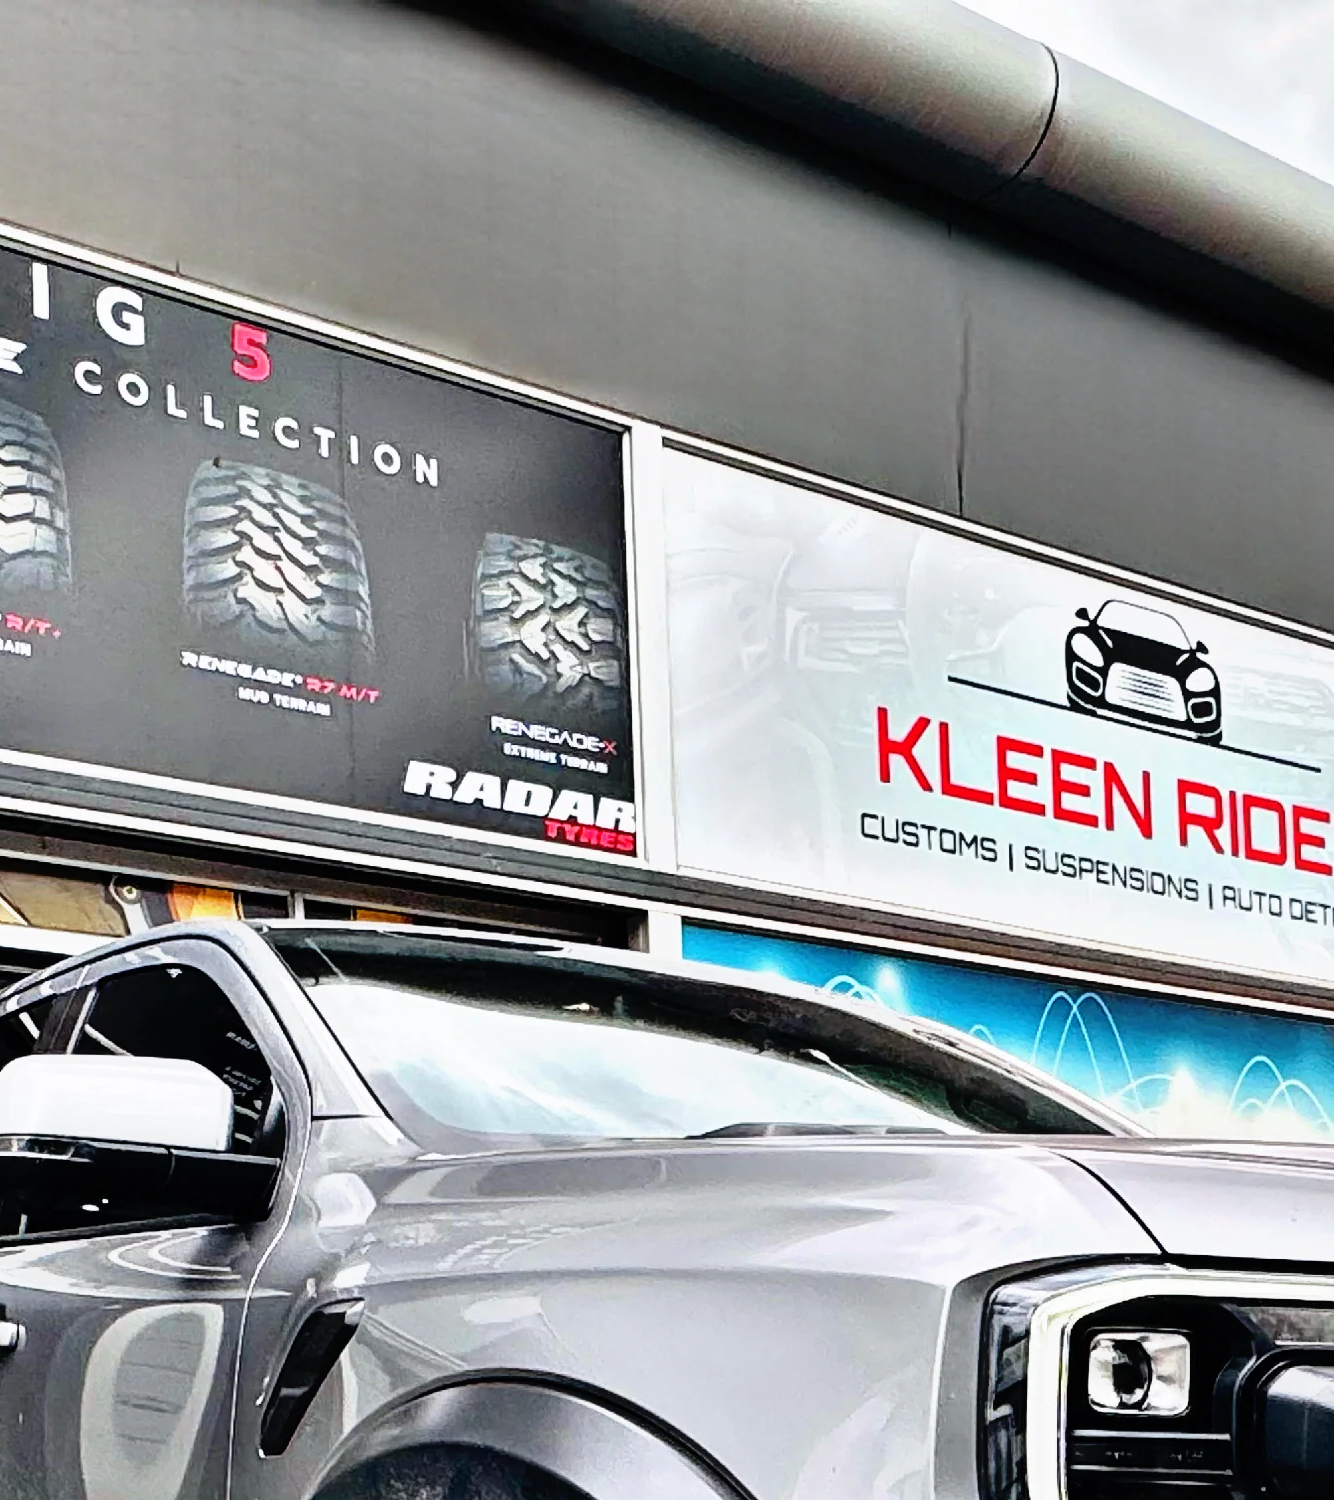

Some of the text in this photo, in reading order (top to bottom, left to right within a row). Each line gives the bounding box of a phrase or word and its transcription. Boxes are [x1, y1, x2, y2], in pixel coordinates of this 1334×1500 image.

[231, 321, 272, 382] 5
[73, 361, 440, 487] COLLECTION
[238, 686, 331, 717] MUD TERRAIN
[402, 760, 636, 833] RADAR
[877, 706, 1153, 840] KLEEN
[544, 818, 635, 852] TYRES
[860, 812, 999, 863] CUSTOMS
[1024, 845, 1200, 903] SUSPENSIONS
[1223, 884, 1284, 918] AUTO
